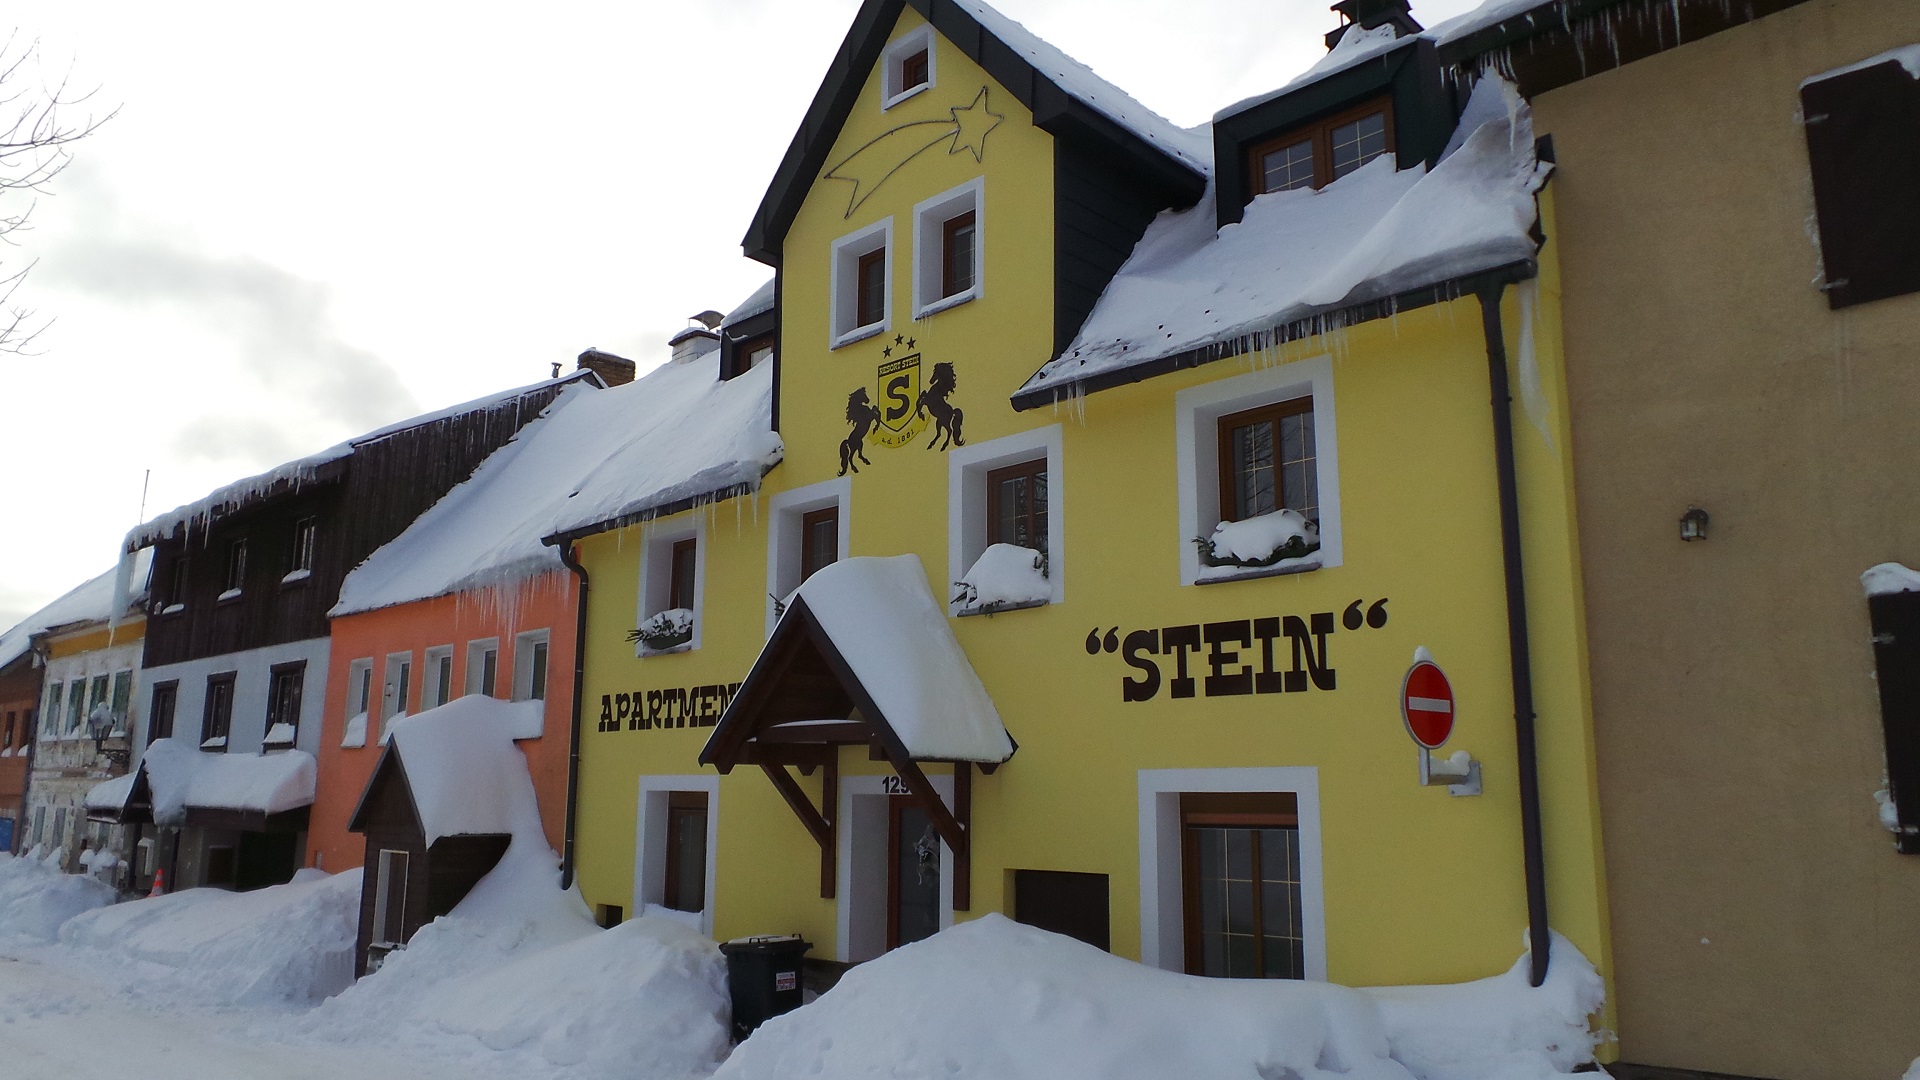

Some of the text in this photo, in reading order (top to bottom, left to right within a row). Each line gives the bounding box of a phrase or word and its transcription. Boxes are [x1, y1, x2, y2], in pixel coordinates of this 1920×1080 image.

[902, 355, 919, 368] STEIN
[886, 374, 910, 422] S
[598, 682, 743, 732] APARTMEN
